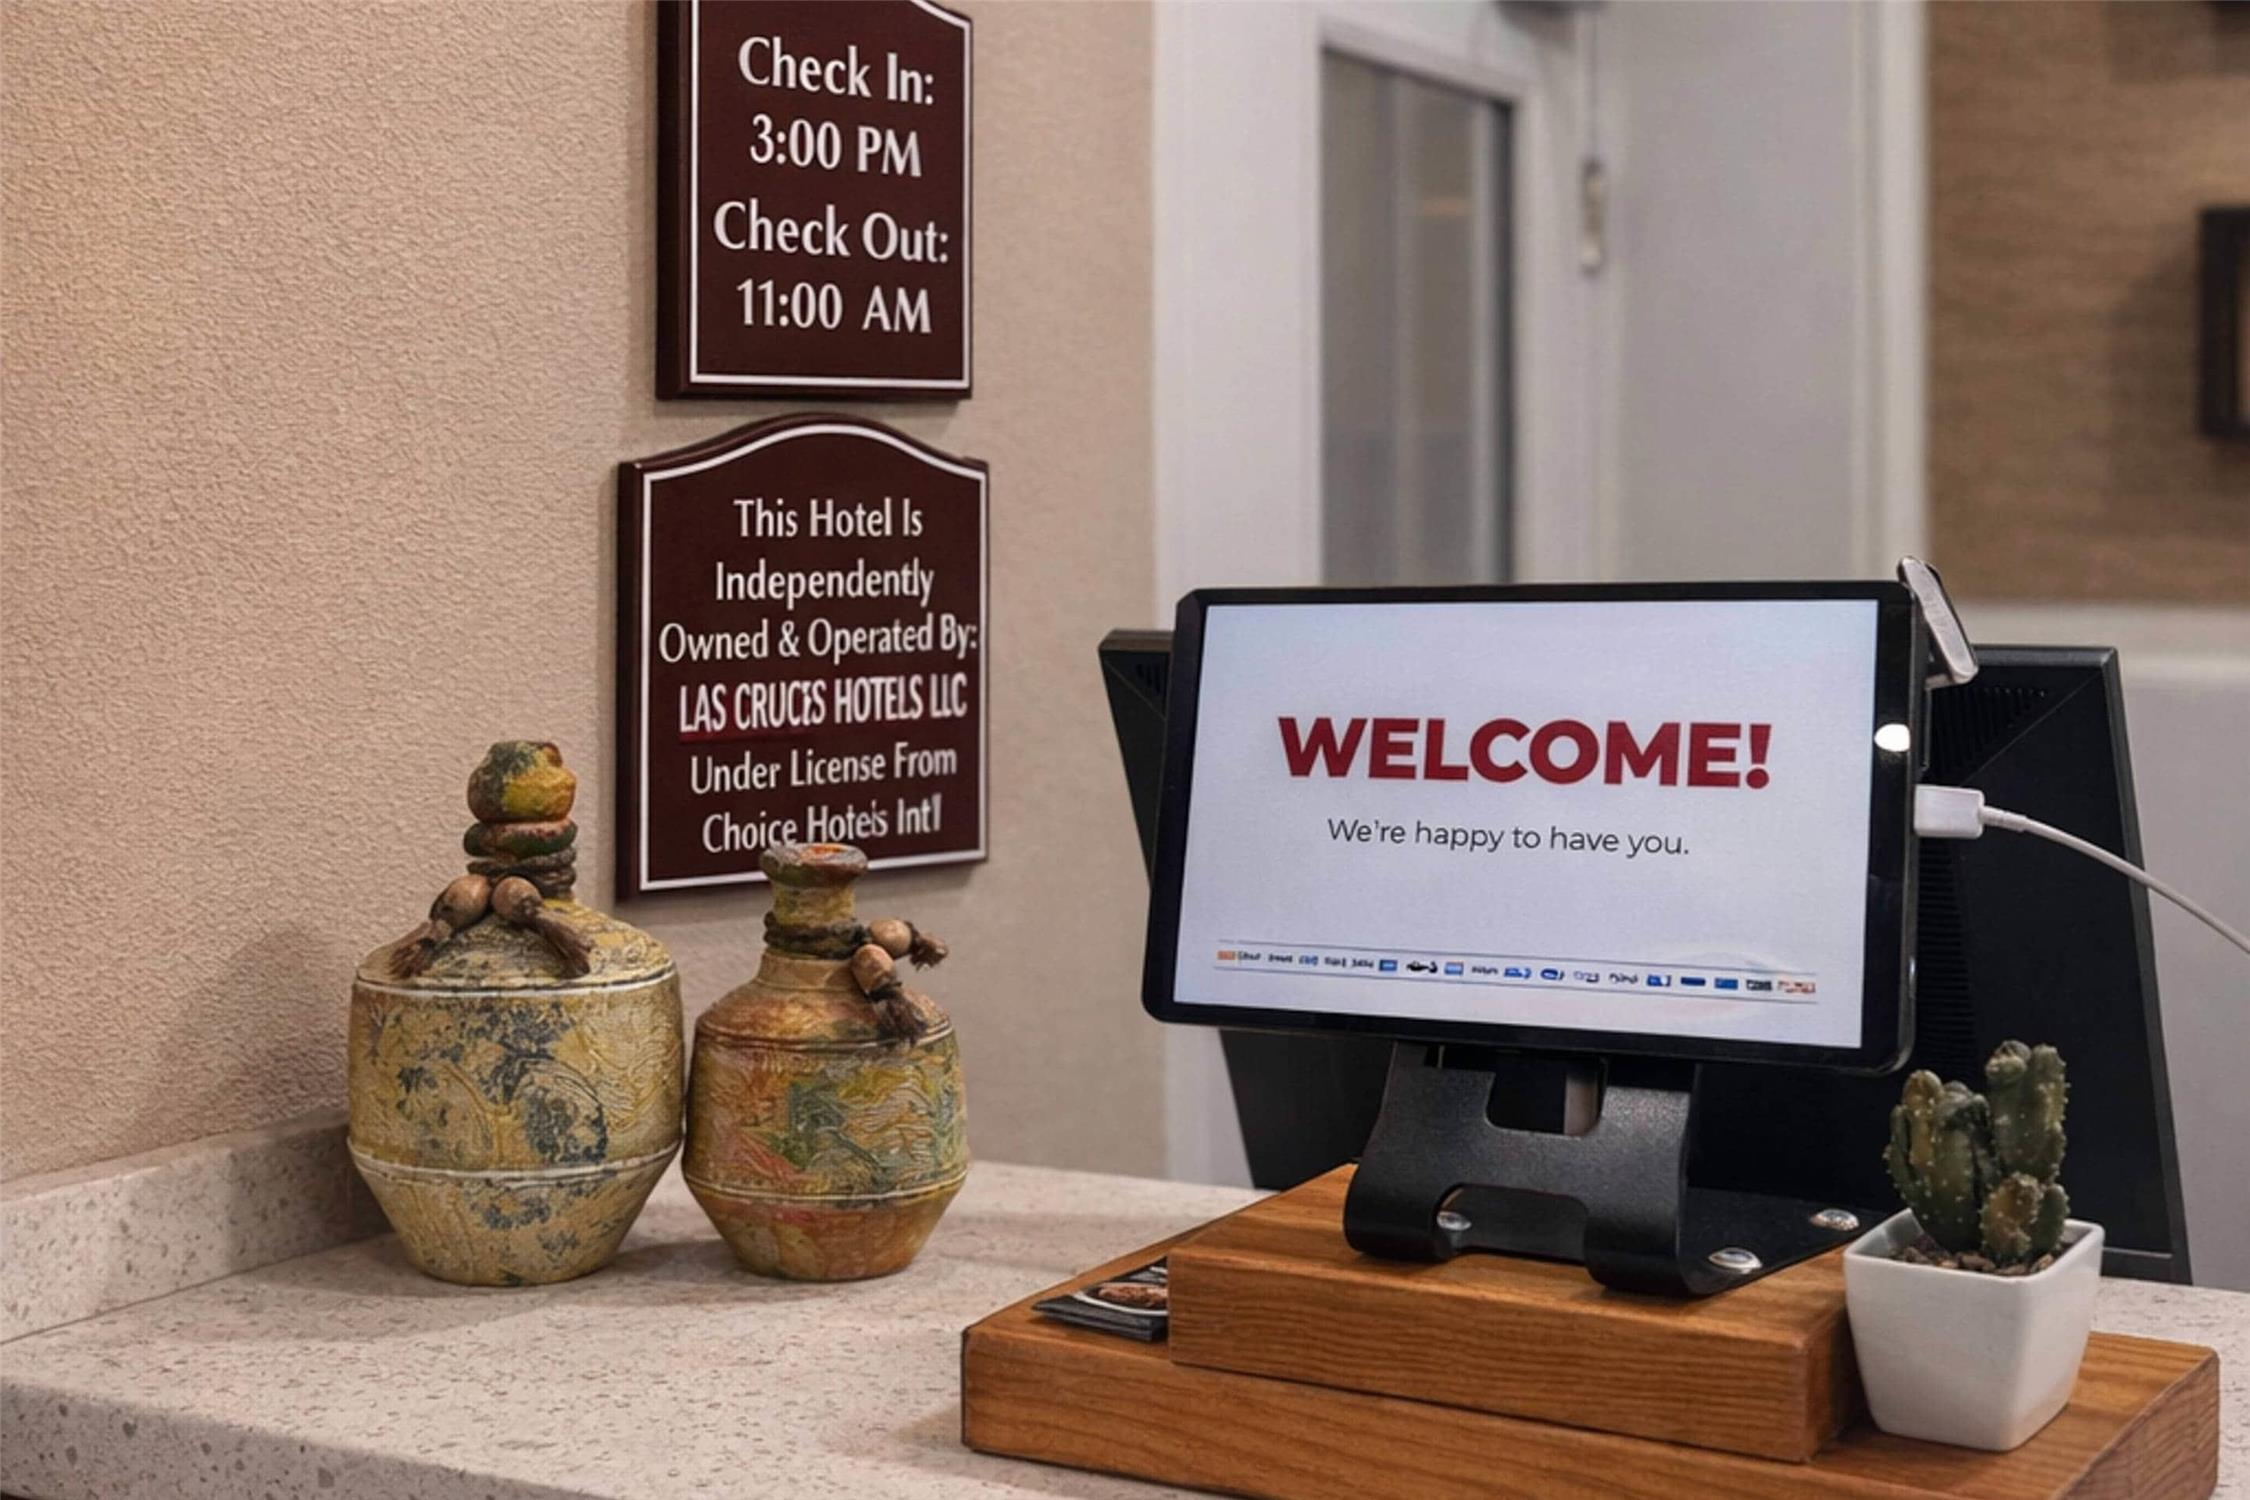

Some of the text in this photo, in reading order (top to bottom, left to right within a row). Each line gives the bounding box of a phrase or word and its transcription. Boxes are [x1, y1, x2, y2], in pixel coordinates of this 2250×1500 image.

[738, 36, 934, 105] Check In:
[750, 113, 922, 177] 3:00 PM
[713, 198, 949, 263] Check Out:
[737, 279, 932, 334] 11:00 AM
[733, 497, 923, 537] This Hotel Is
[716, 556, 935, 611] Independently
[659, 611, 978, 666] Owned & Operated By:
[680, 683, 727, 733] LAS
[834, 673, 924, 724] HOTELS
[930, 671, 968, 718] LLC
[690, 741, 957, 795] Under License From
[1277, 716, 1773, 790] WELCOME!
[702, 810, 798, 853] Choice
[1327, 818, 1690, 859] We're happy to have you.
